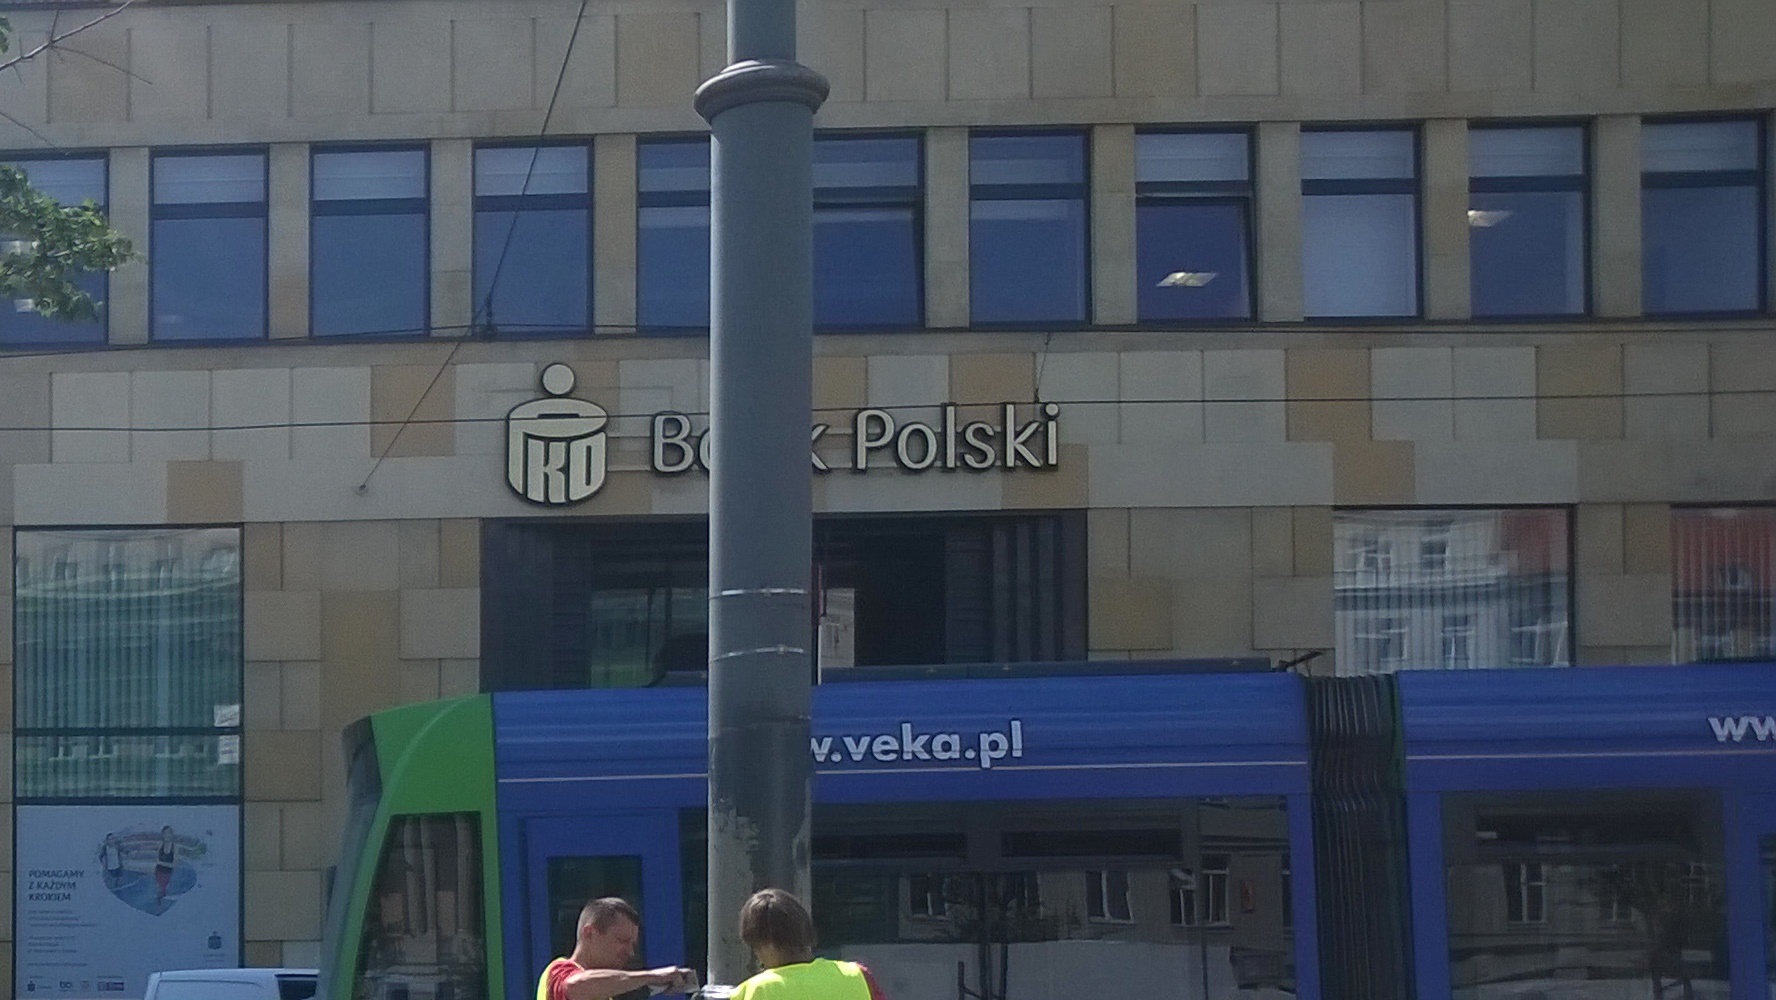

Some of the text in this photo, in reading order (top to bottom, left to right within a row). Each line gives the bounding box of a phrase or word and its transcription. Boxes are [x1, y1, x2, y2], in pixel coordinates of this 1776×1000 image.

[854, 402, 1061, 472] Polski
[811, 720, 1023, 769] w.veka.pl
[28, 870, 85, 879] POMAGAMY
[28, 893, 71, 902] KROKIEM
